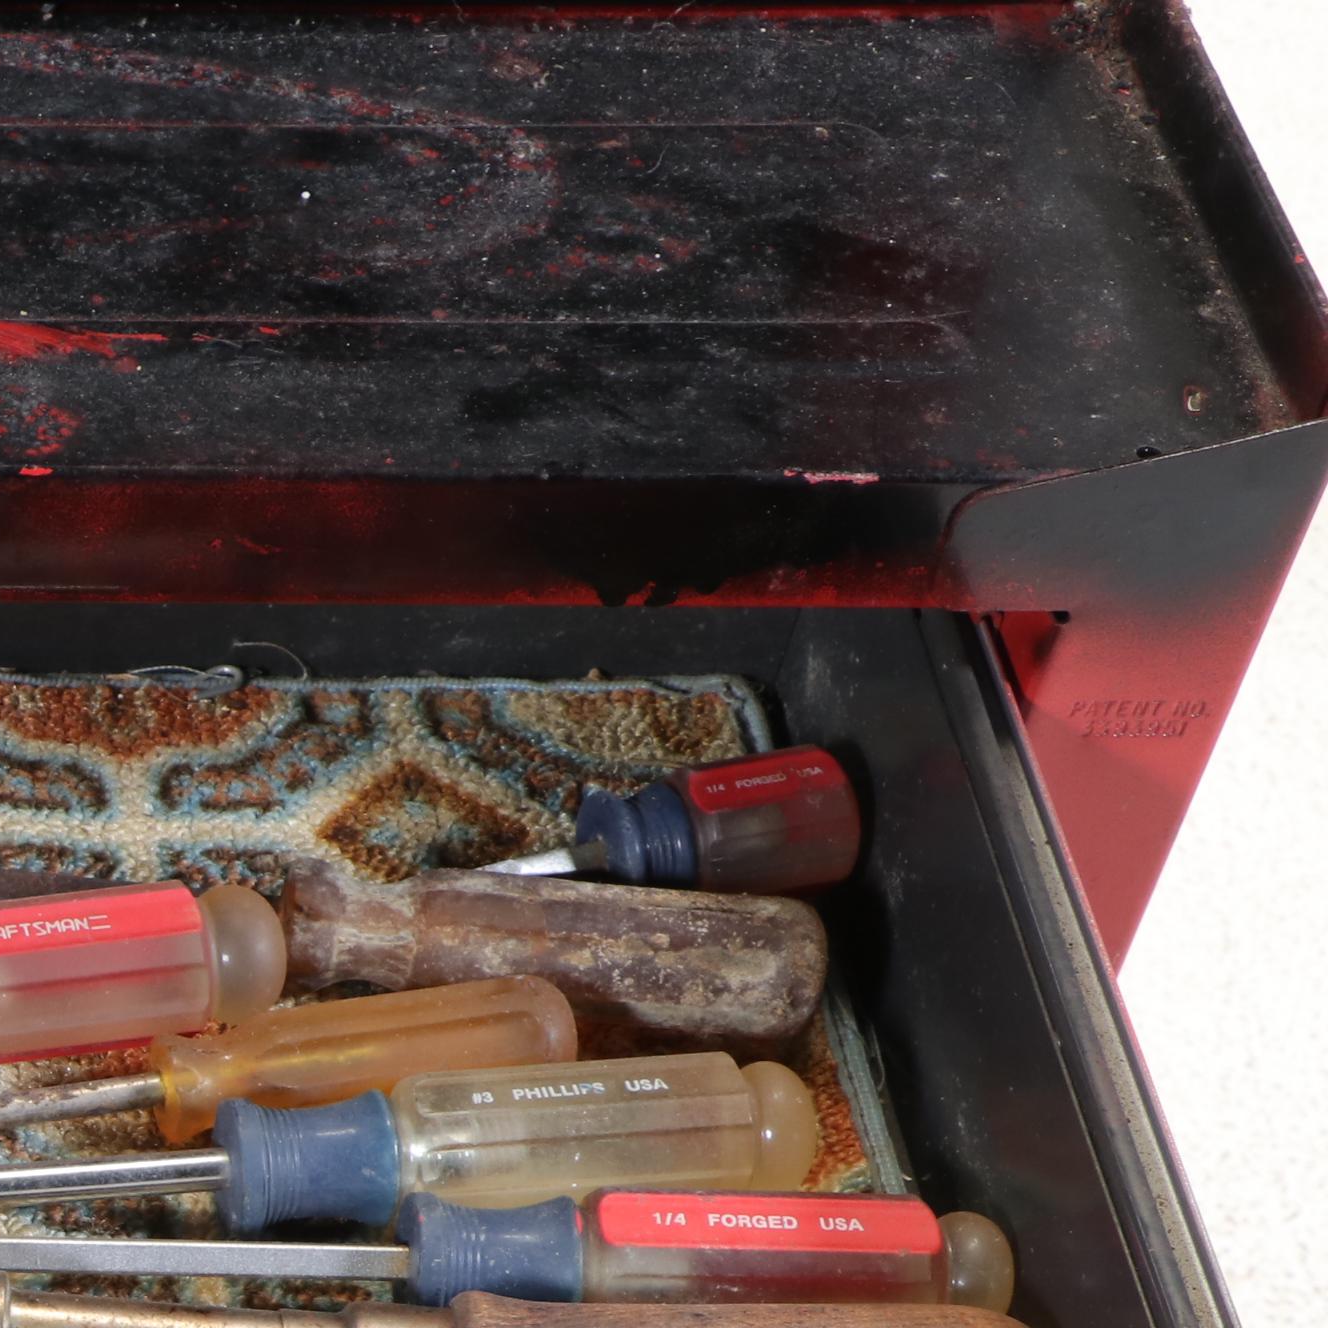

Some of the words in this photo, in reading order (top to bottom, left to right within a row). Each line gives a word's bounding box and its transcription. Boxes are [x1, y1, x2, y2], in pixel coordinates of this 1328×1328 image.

[1069, 701, 1166, 717] PATENT
[1173, 701, 1210, 718] NO.
[735, 772, 787, 789] FORGED
[796, 766, 824, 778] USA
[472, 1091, 494, 1104] #3
[512, 1082, 605, 1101] PHILLIPS
[624, 1078, 669, 1092] USA
[652, 1212, 687, 1226] 1/4
[708, 1213, 798, 1230] FORGED
[820, 1216, 865, 1232] USA
